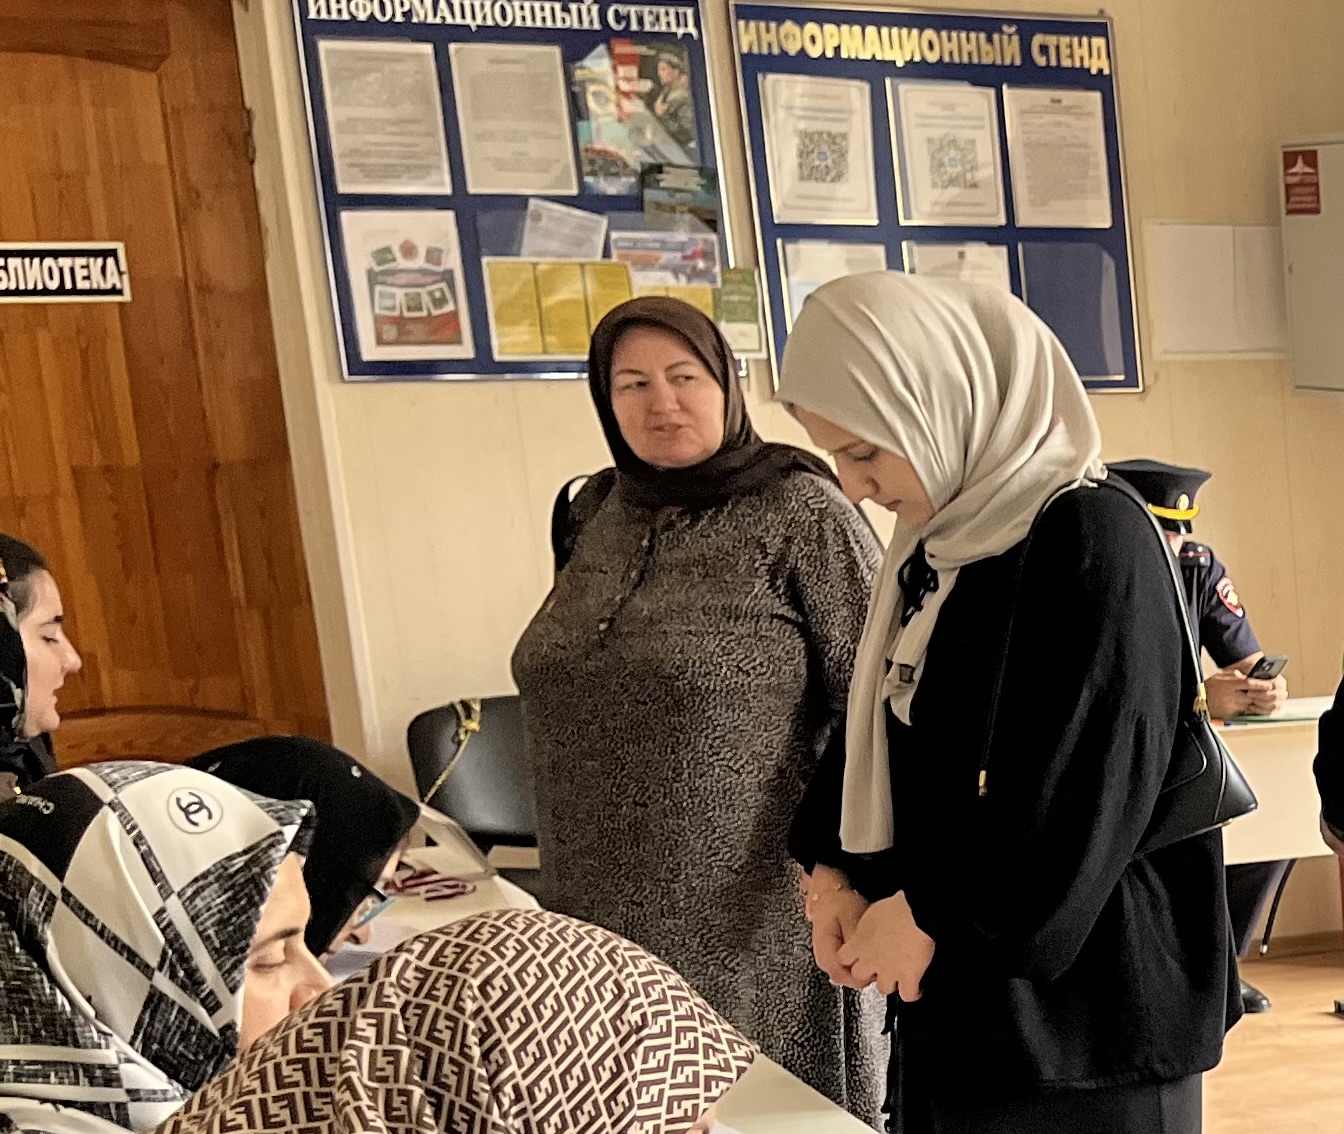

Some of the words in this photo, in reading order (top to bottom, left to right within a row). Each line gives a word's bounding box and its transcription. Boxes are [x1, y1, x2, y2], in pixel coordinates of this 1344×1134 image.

[307, 0, 600, 31] ИНФОРМАЦИОННЫЙ
[606, 5, 699, 39] СТЕНД
[737, 19, 1023, 67] ИНФОРМАЦИОННЫЙ
[1030, 33, 1111, 75] СТЕНД
